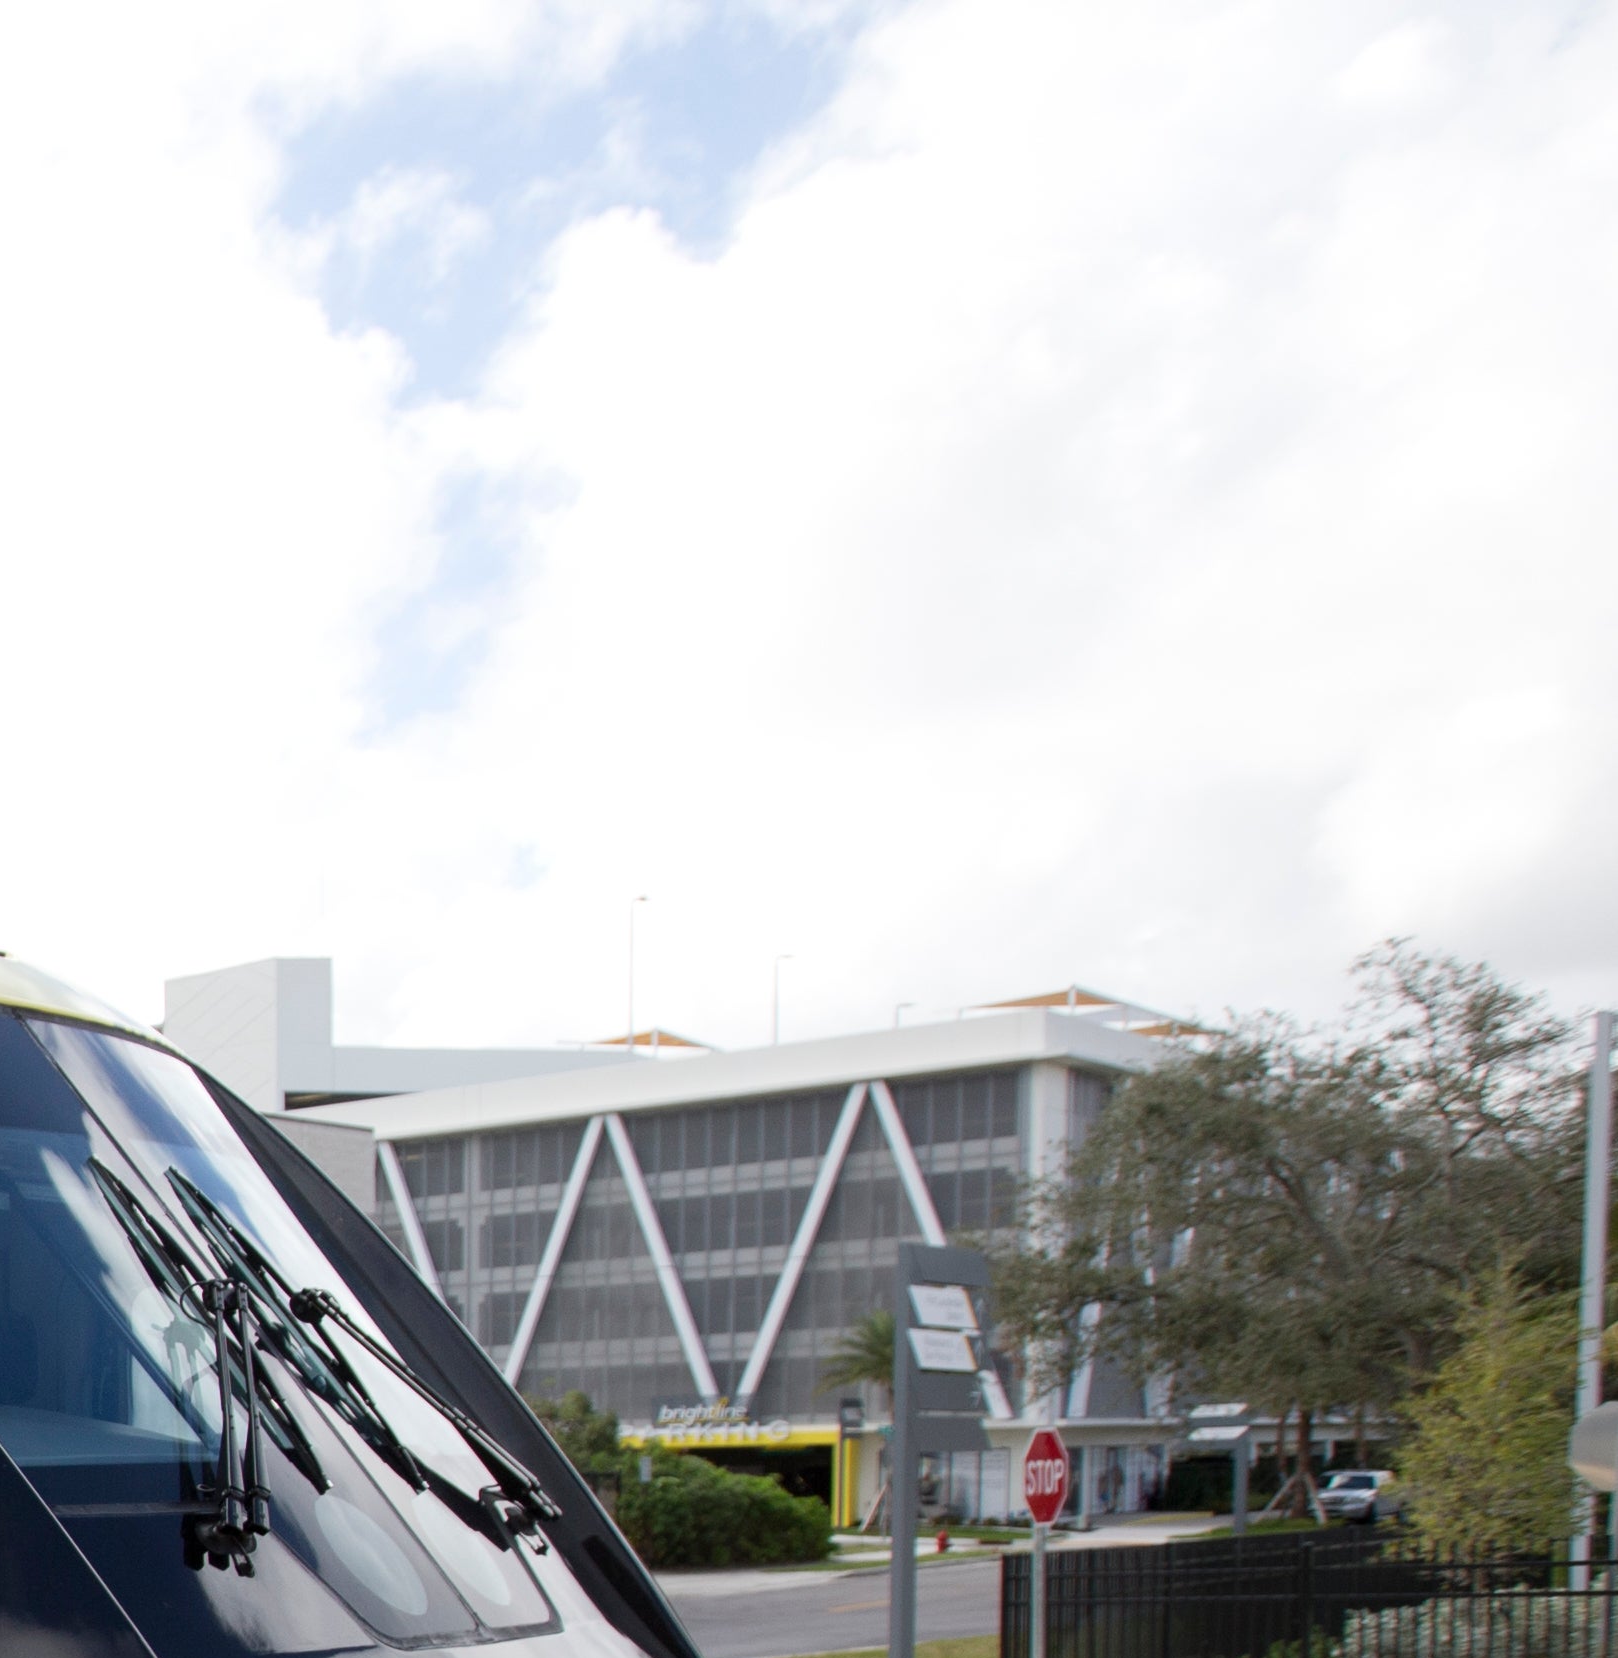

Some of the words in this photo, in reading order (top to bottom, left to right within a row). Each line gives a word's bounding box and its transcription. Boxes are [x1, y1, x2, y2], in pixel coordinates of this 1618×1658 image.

[657, 1403, 747, 1427] brightline
[618, 1419, 790, 1443] PARKING
[1026, 1459, 1064, 1495] STOP
